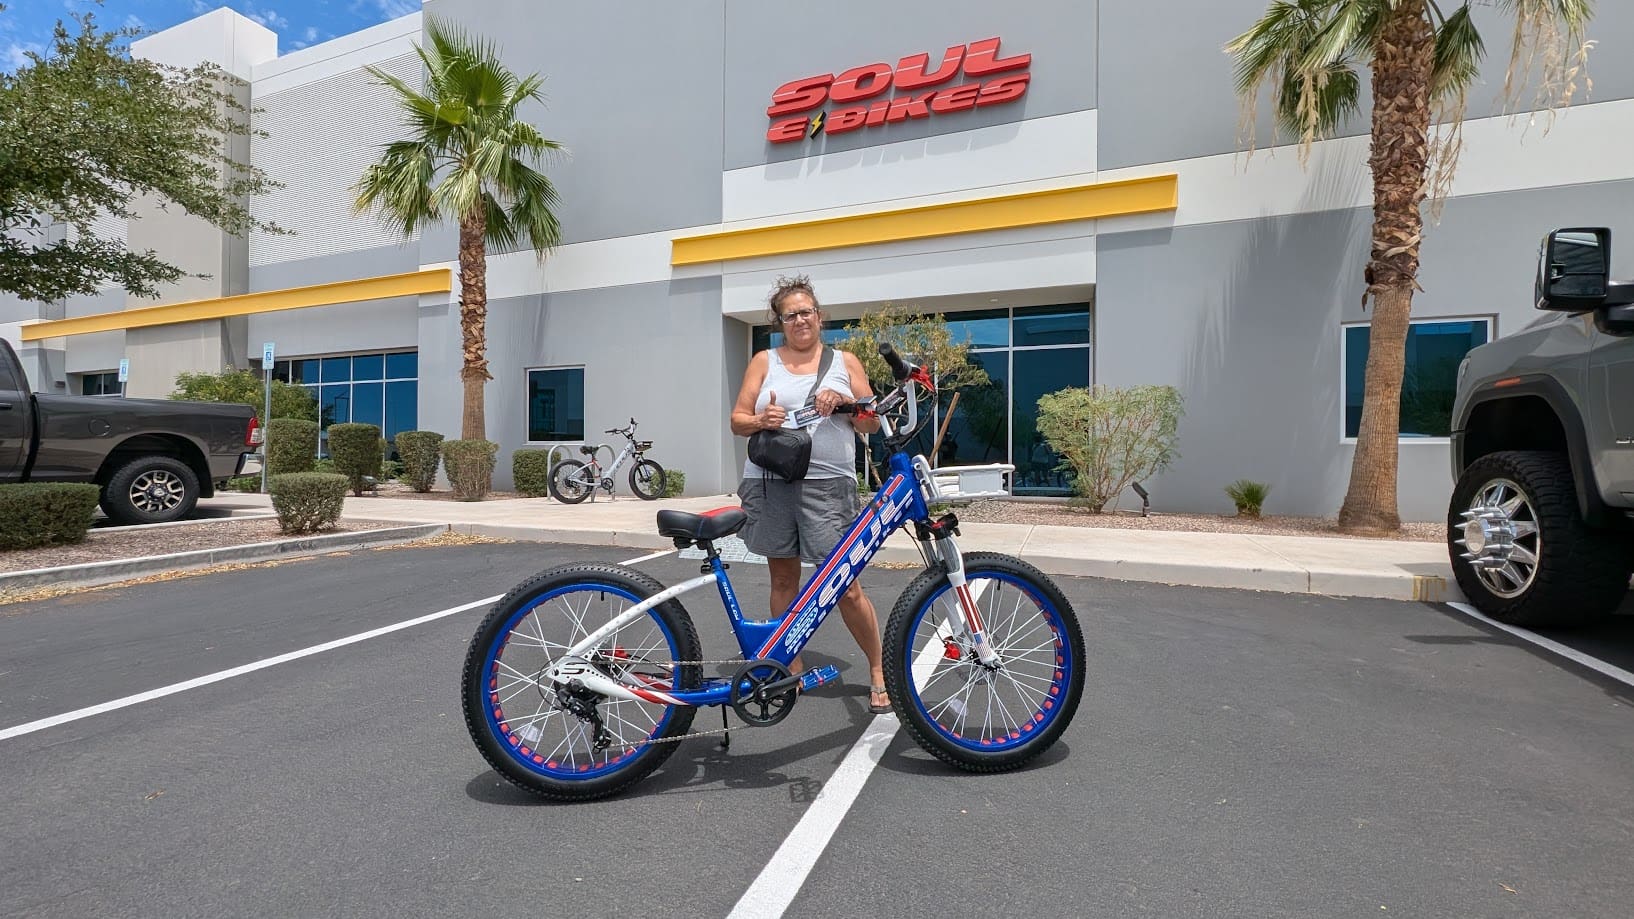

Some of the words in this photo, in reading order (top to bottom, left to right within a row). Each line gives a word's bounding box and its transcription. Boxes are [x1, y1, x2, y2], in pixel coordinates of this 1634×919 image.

[766, 37, 1032, 118] SOUL
[766, 116, 810, 143] E
[824, 72, 1032, 135] BIKES
[785, 488, 914, 655] SOUL
